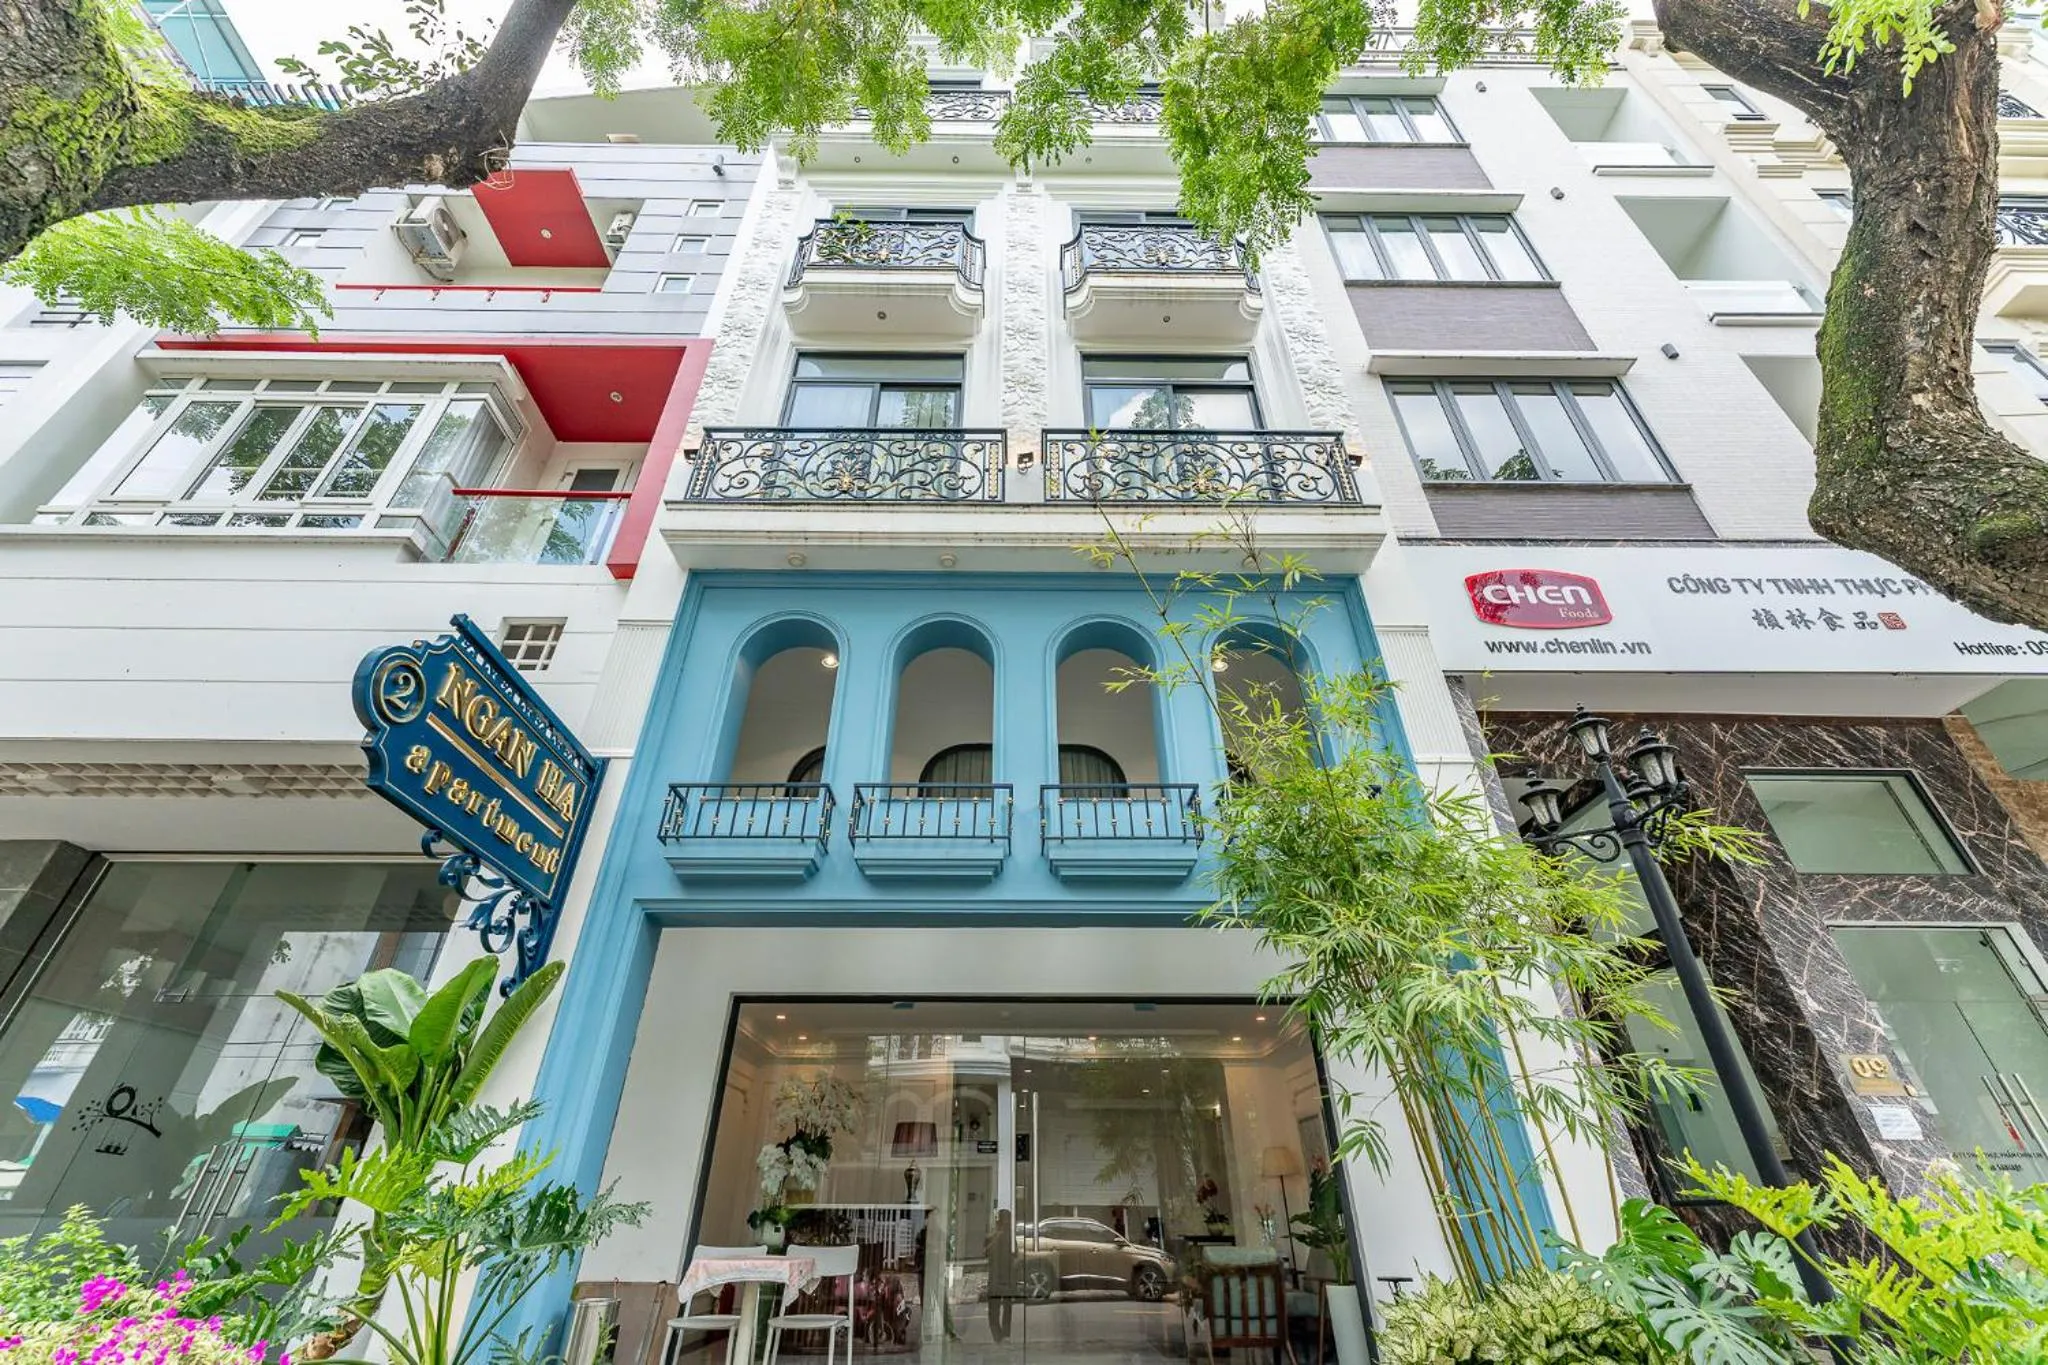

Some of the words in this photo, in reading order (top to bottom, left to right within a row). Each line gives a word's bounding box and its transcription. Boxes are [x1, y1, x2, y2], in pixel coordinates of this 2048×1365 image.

[1667, 573, 1731, 594] CÔNG
[1731, 578, 1764, 594] TY
[1766, 578, 1835, 595] TNHH
[1835, 577, 1902, 598] THỰC
[1560, 607, 1599, 618] Foods
[1485, 638, 1652, 655] www.chenlin.vn
[384, 672, 416, 710] 2
[436, 661, 541, 779] NGAN
[534, 758, 577, 822] HA
[405, 744, 561, 874] apartment
[1851, 1057, 1888, 1078] 09
